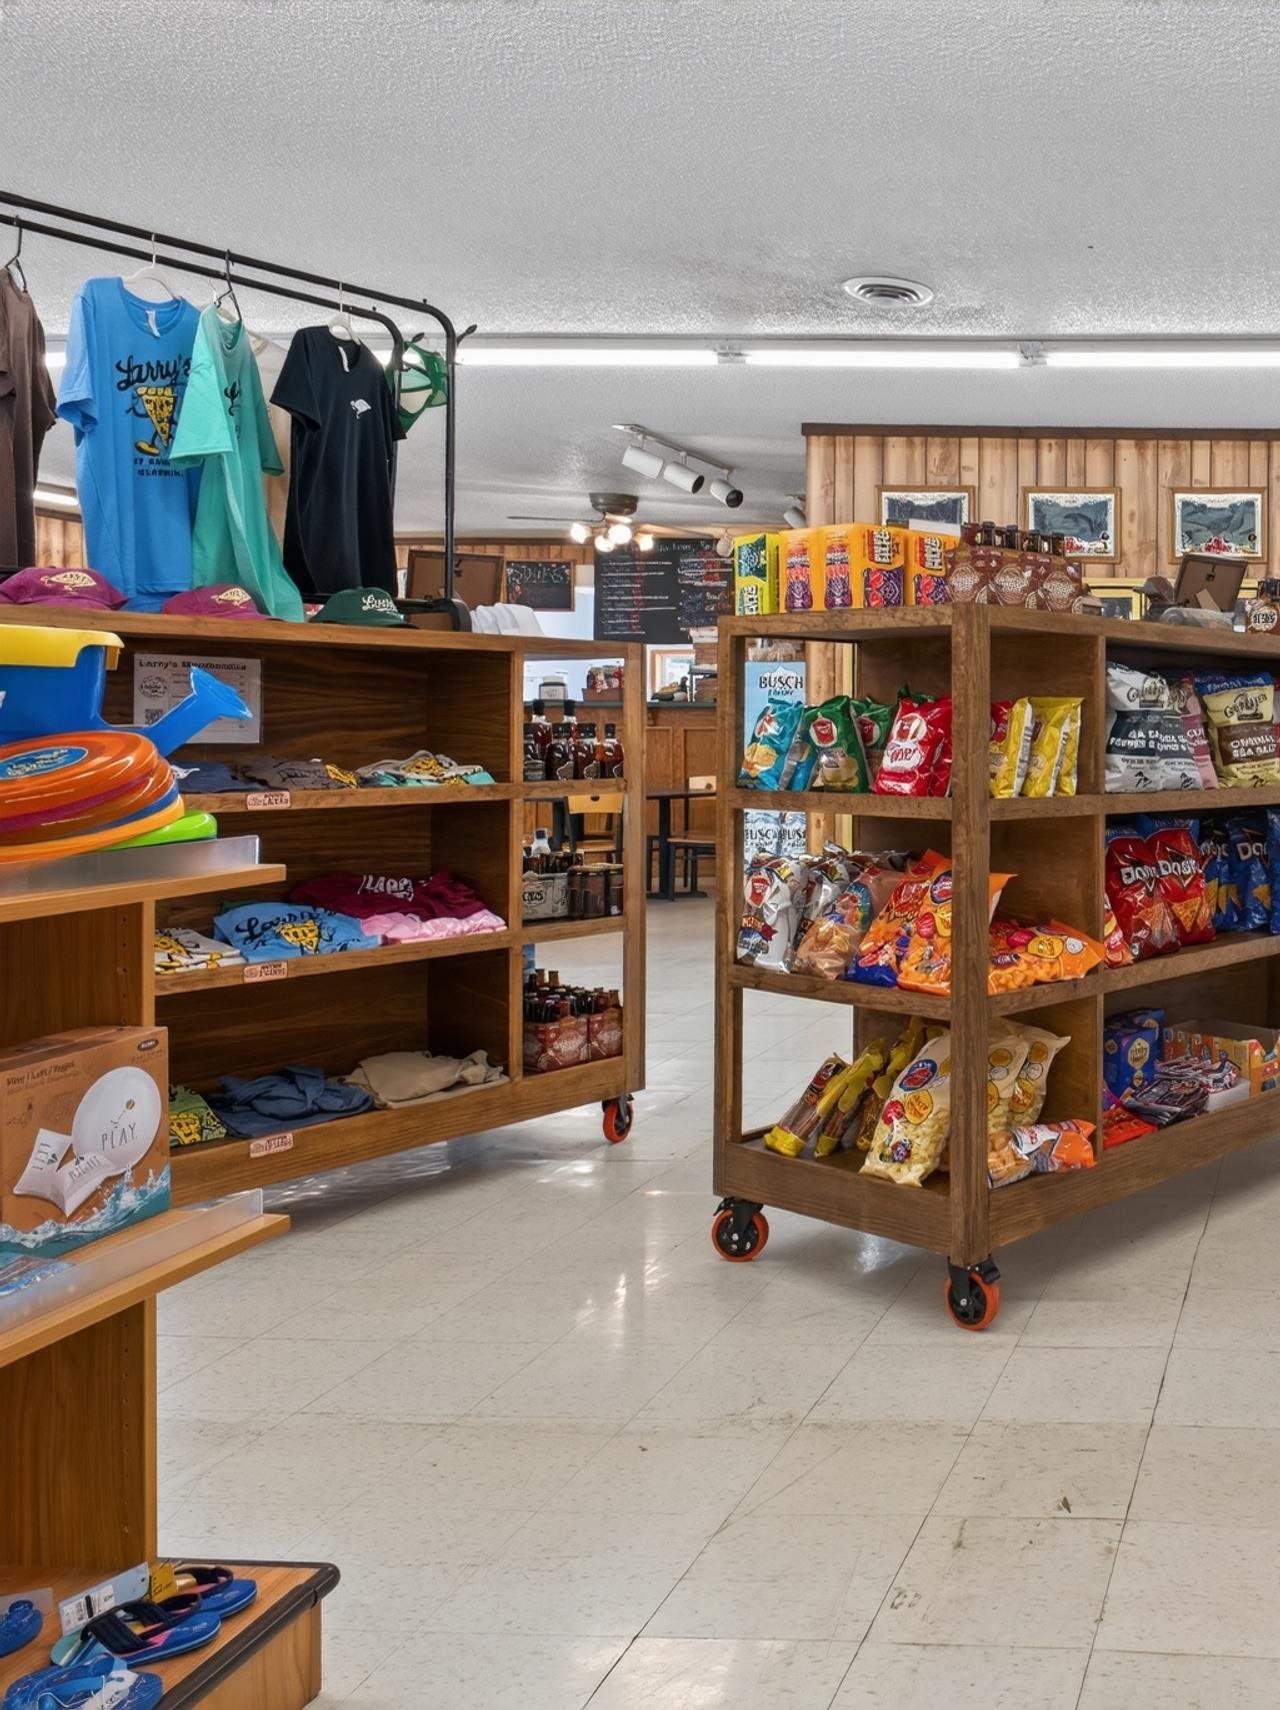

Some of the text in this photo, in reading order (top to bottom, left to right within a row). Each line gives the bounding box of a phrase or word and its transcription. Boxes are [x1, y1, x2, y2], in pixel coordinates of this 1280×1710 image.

[115, 354, 192, 391] Larry's
[759, 675, 804, 689] BUSCH
[101, 1122, 138, 1151] PLAY
